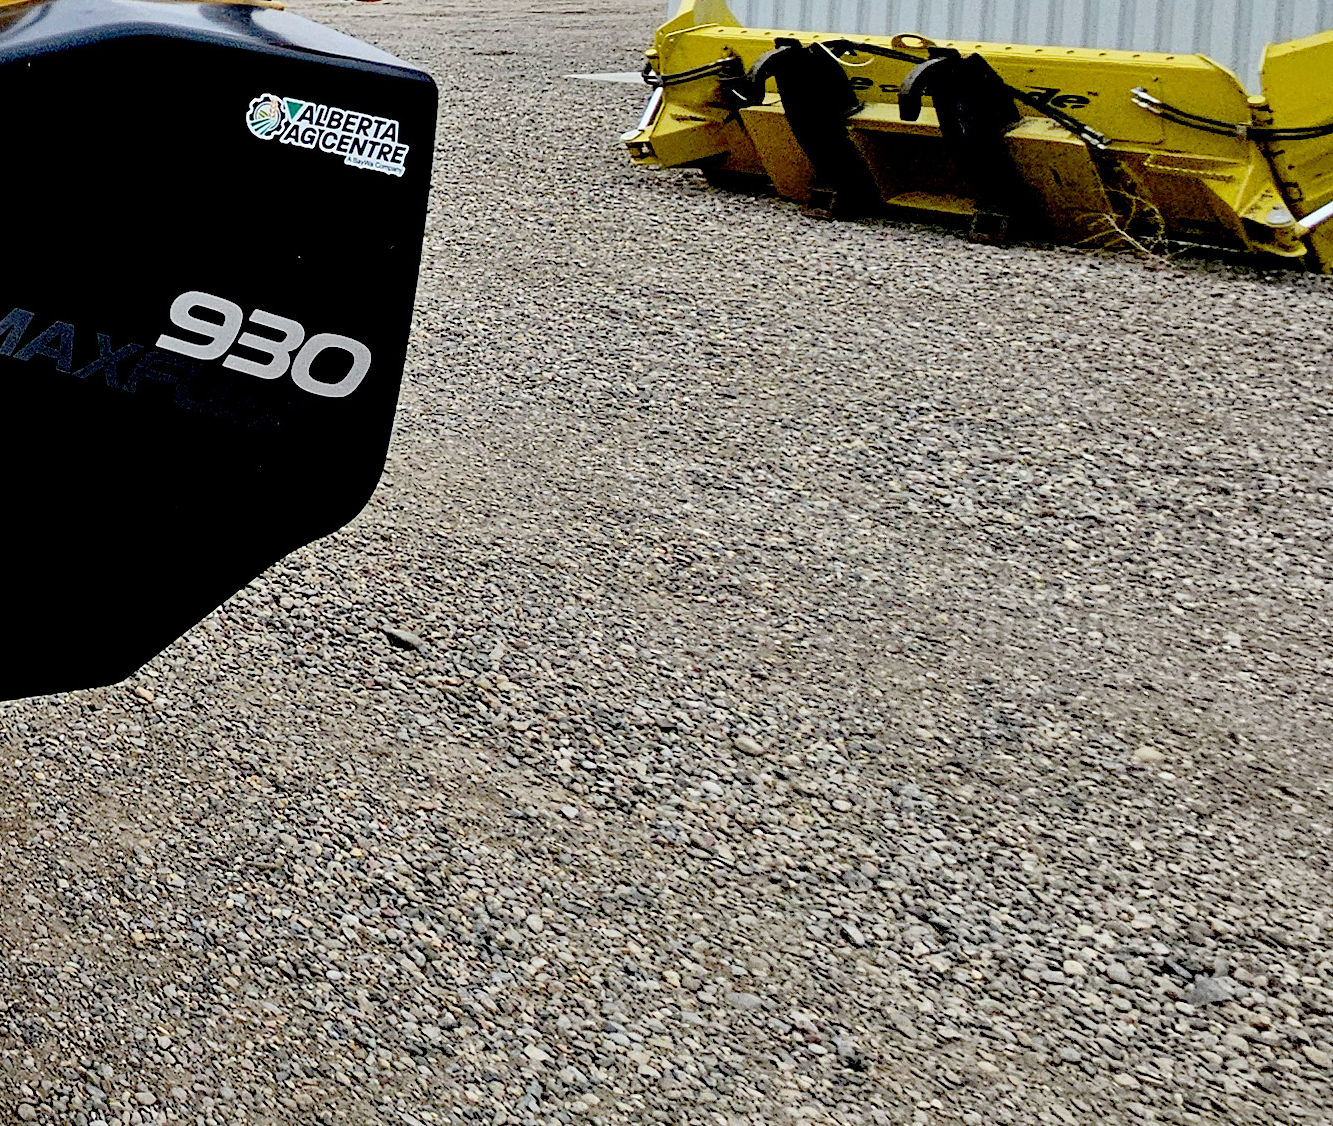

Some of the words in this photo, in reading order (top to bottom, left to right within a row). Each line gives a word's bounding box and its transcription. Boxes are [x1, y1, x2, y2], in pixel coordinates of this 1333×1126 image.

[283, 123, 317, 146] AG
[320, 131, 407, 165] CENTRE
[296, 105, 398, 142] ALBERTA
[155, 290, 372, 398] 930
